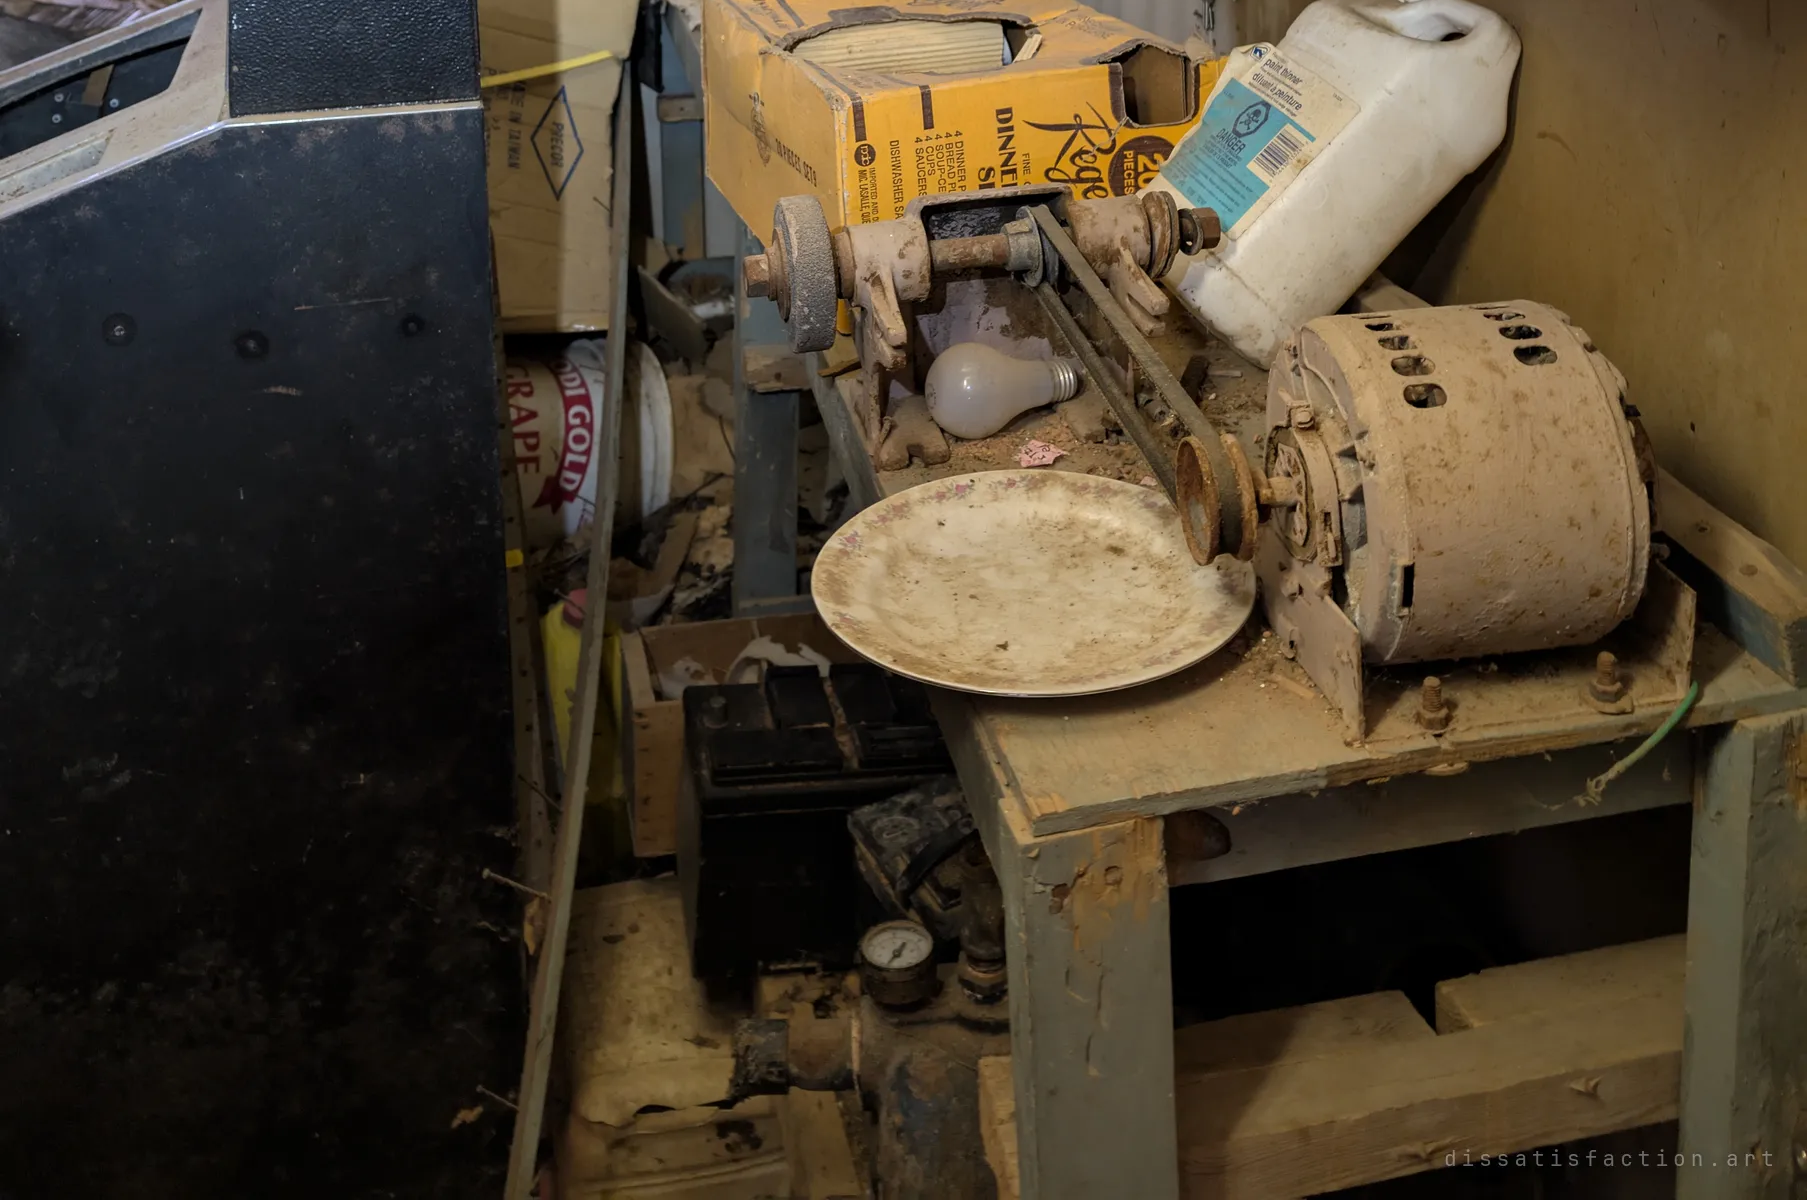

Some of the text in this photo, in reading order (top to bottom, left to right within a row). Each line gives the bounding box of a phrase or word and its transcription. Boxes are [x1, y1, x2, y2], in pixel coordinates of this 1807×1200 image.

[1263, 58, 1282, 76] paint
[1280, 67, 1303, 85] thinner
[1252, 73, 1272, 91] diluant
[1273, 87, 1303, 111] peinture
[507, 129, 522, 169] TAIWAN
[944, 131, 953, 139] 4
[1216, 128, 1247, 154] DANGER
[889, 140, 904, 204] DISHWASHER
[915, 147, 928, 197] SAUCERS
[925, 145, 936, 176] CUPS
[945, 142, 956, 180] BREAD
[955, 141, 967, 183] DINNER
[1021, 152, 1032, 176] FINE
[1123, 150, 1136, 195] PIECES
[869, 167, 878, 200] IMPORTED
[871, 202, 879, 215] AND
[558, 404, 591, 497] GOLD
